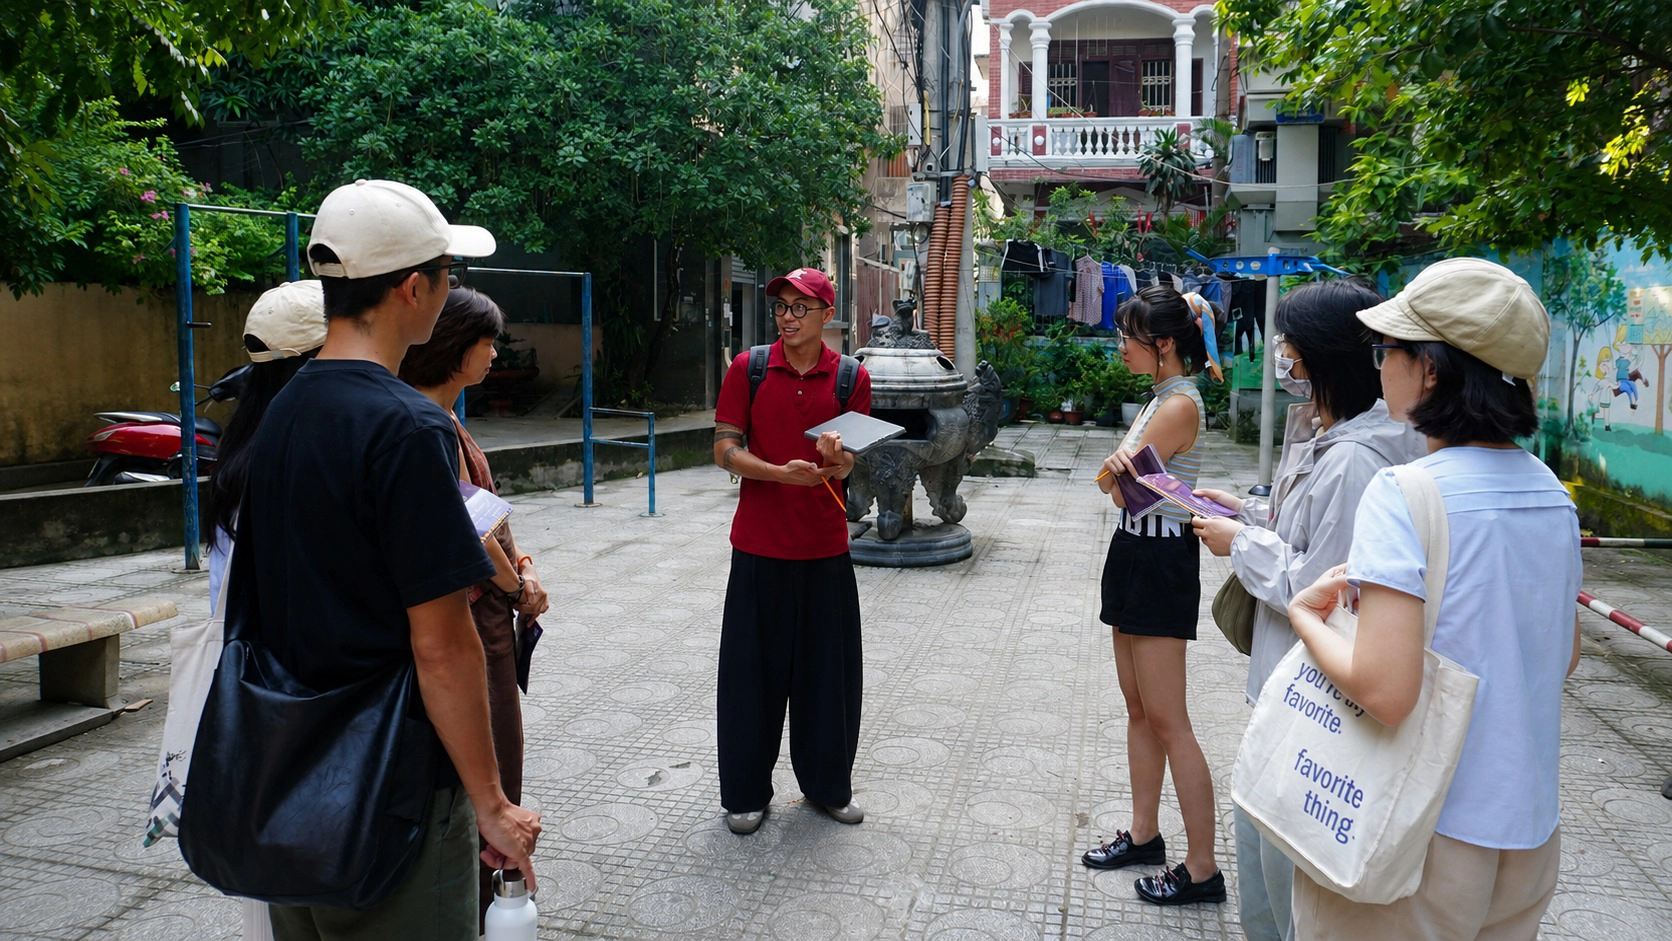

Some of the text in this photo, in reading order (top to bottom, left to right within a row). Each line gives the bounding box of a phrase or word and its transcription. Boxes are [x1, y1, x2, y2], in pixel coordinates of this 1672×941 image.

[1294, 662, 1342, 701] youre
[1283, 683, 1342, 734] favorite.
[1294, 748, 1364, 809] favorite
[1303, 790, 1355, 845] thing.
